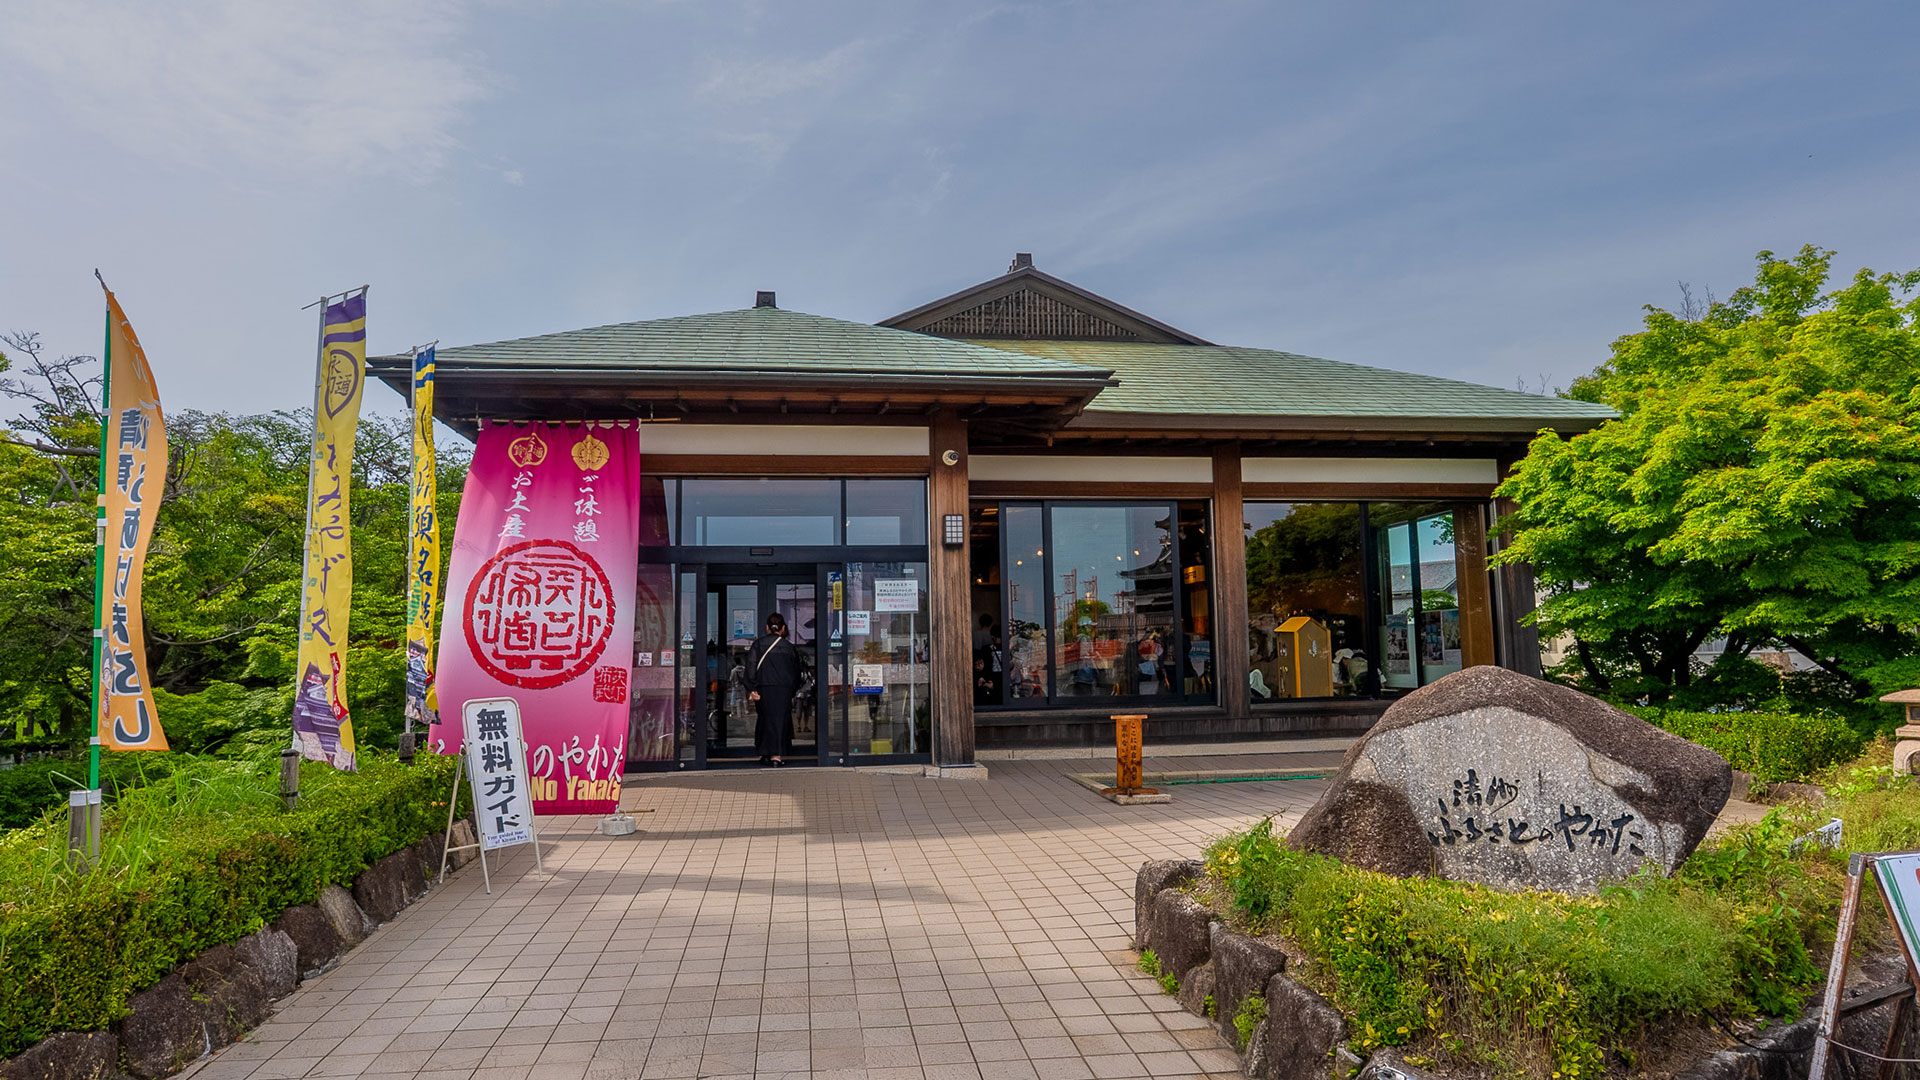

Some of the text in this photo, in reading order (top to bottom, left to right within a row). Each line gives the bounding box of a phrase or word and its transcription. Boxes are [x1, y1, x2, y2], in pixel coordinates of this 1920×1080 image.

[498, 470, 534, 539] お土産
[572, 474, 602, 542] ご休憩
[476, 708, 521, 834] 無料ガイド
[532, 775, 558, 801] No
[1428, 797, 1646, 857] ふるさとのやかた
